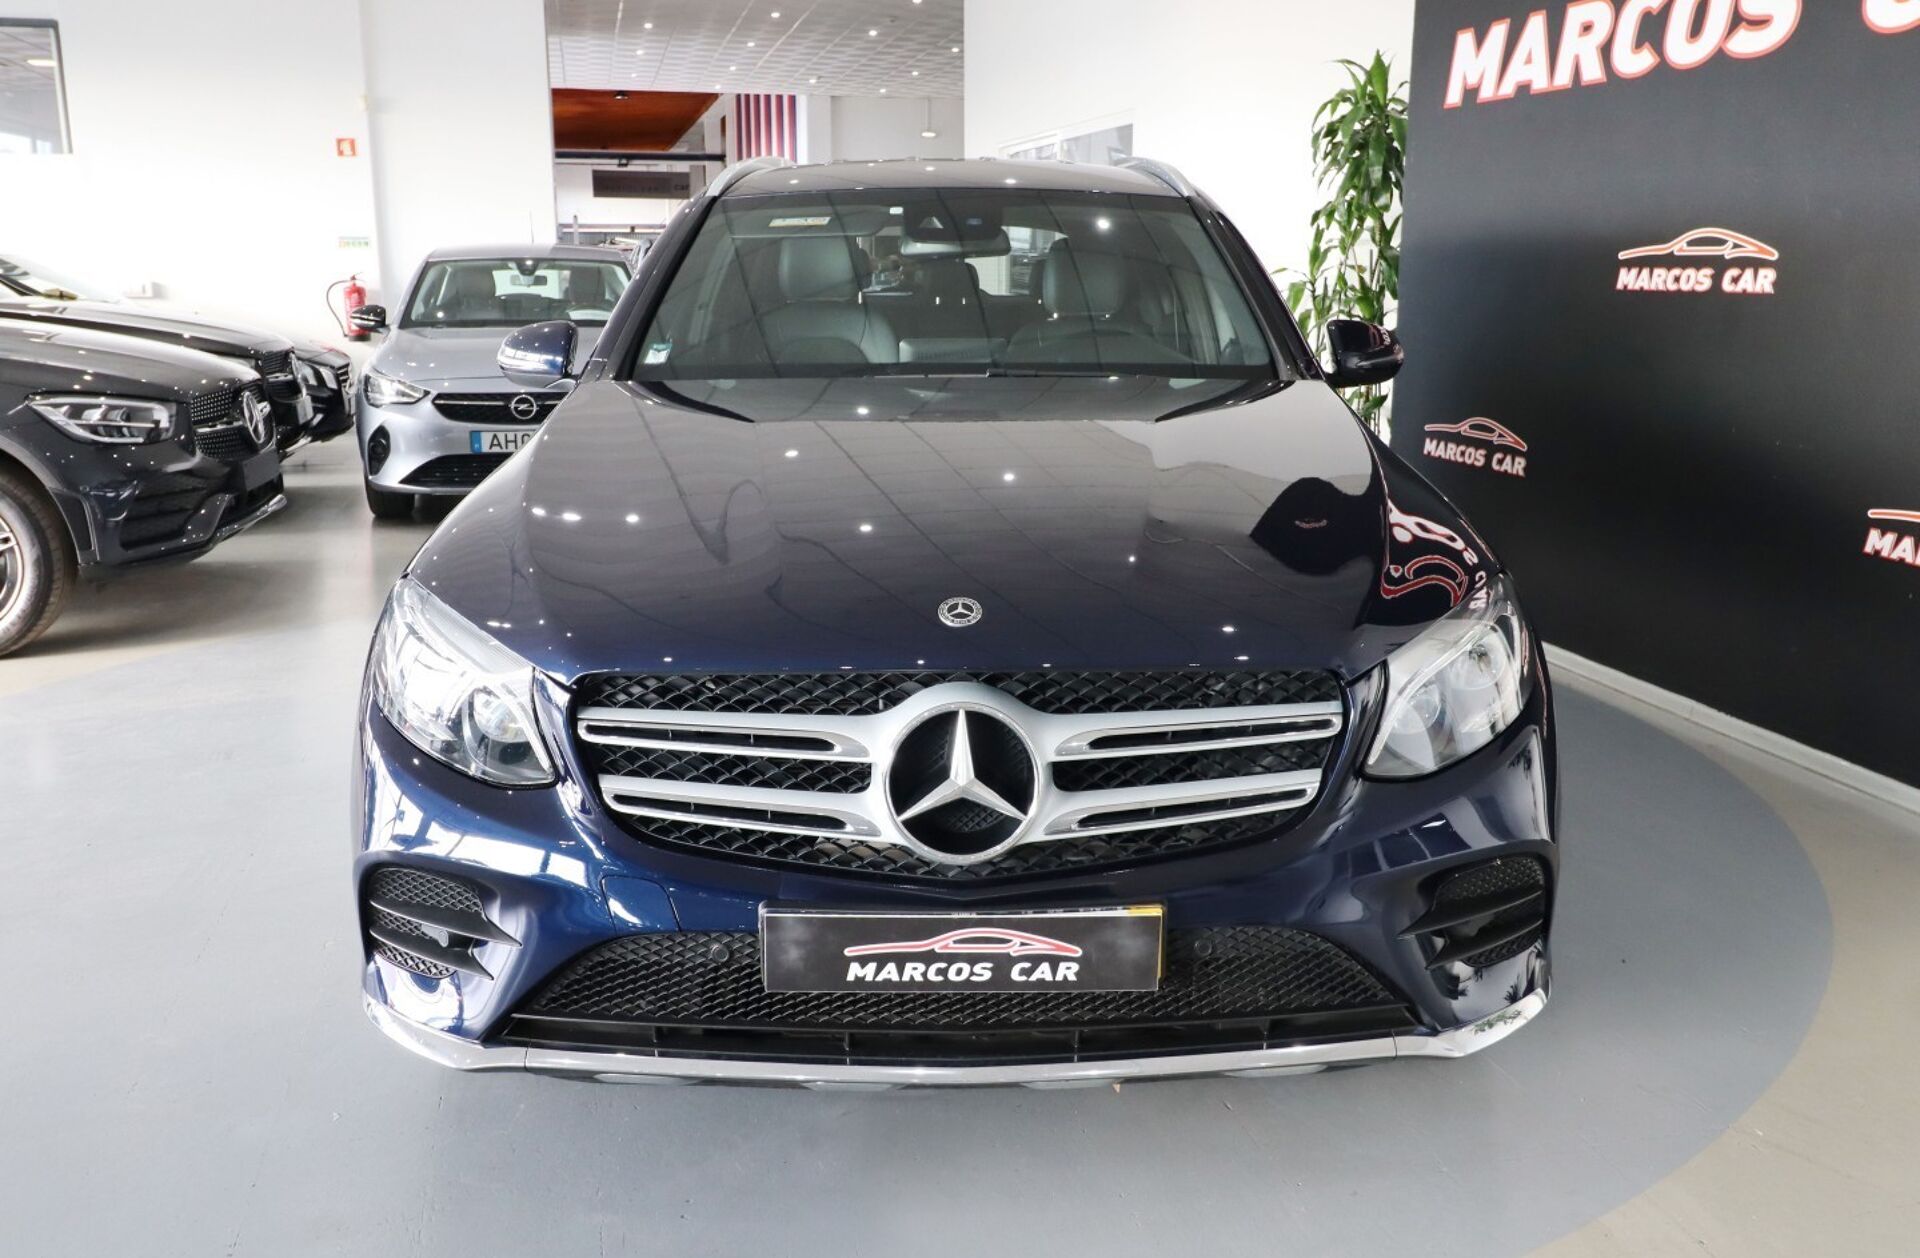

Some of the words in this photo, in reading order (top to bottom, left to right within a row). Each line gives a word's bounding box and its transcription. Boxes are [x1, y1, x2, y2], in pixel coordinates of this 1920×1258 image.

[1443, 0, 1802, 109] MARCOS
[1616, 266, 1715, 293] MARCOS
[1721, 267, 1777, 295] CAR
[1423, 437, 1487, 467] MARCOS
[1491, 452, 1527, 477] CAR
[1863, 527, 1920, 568] MA
[845, 961, 993, 982] MARCOS
[1010, 961, 1081, 982] CAR
